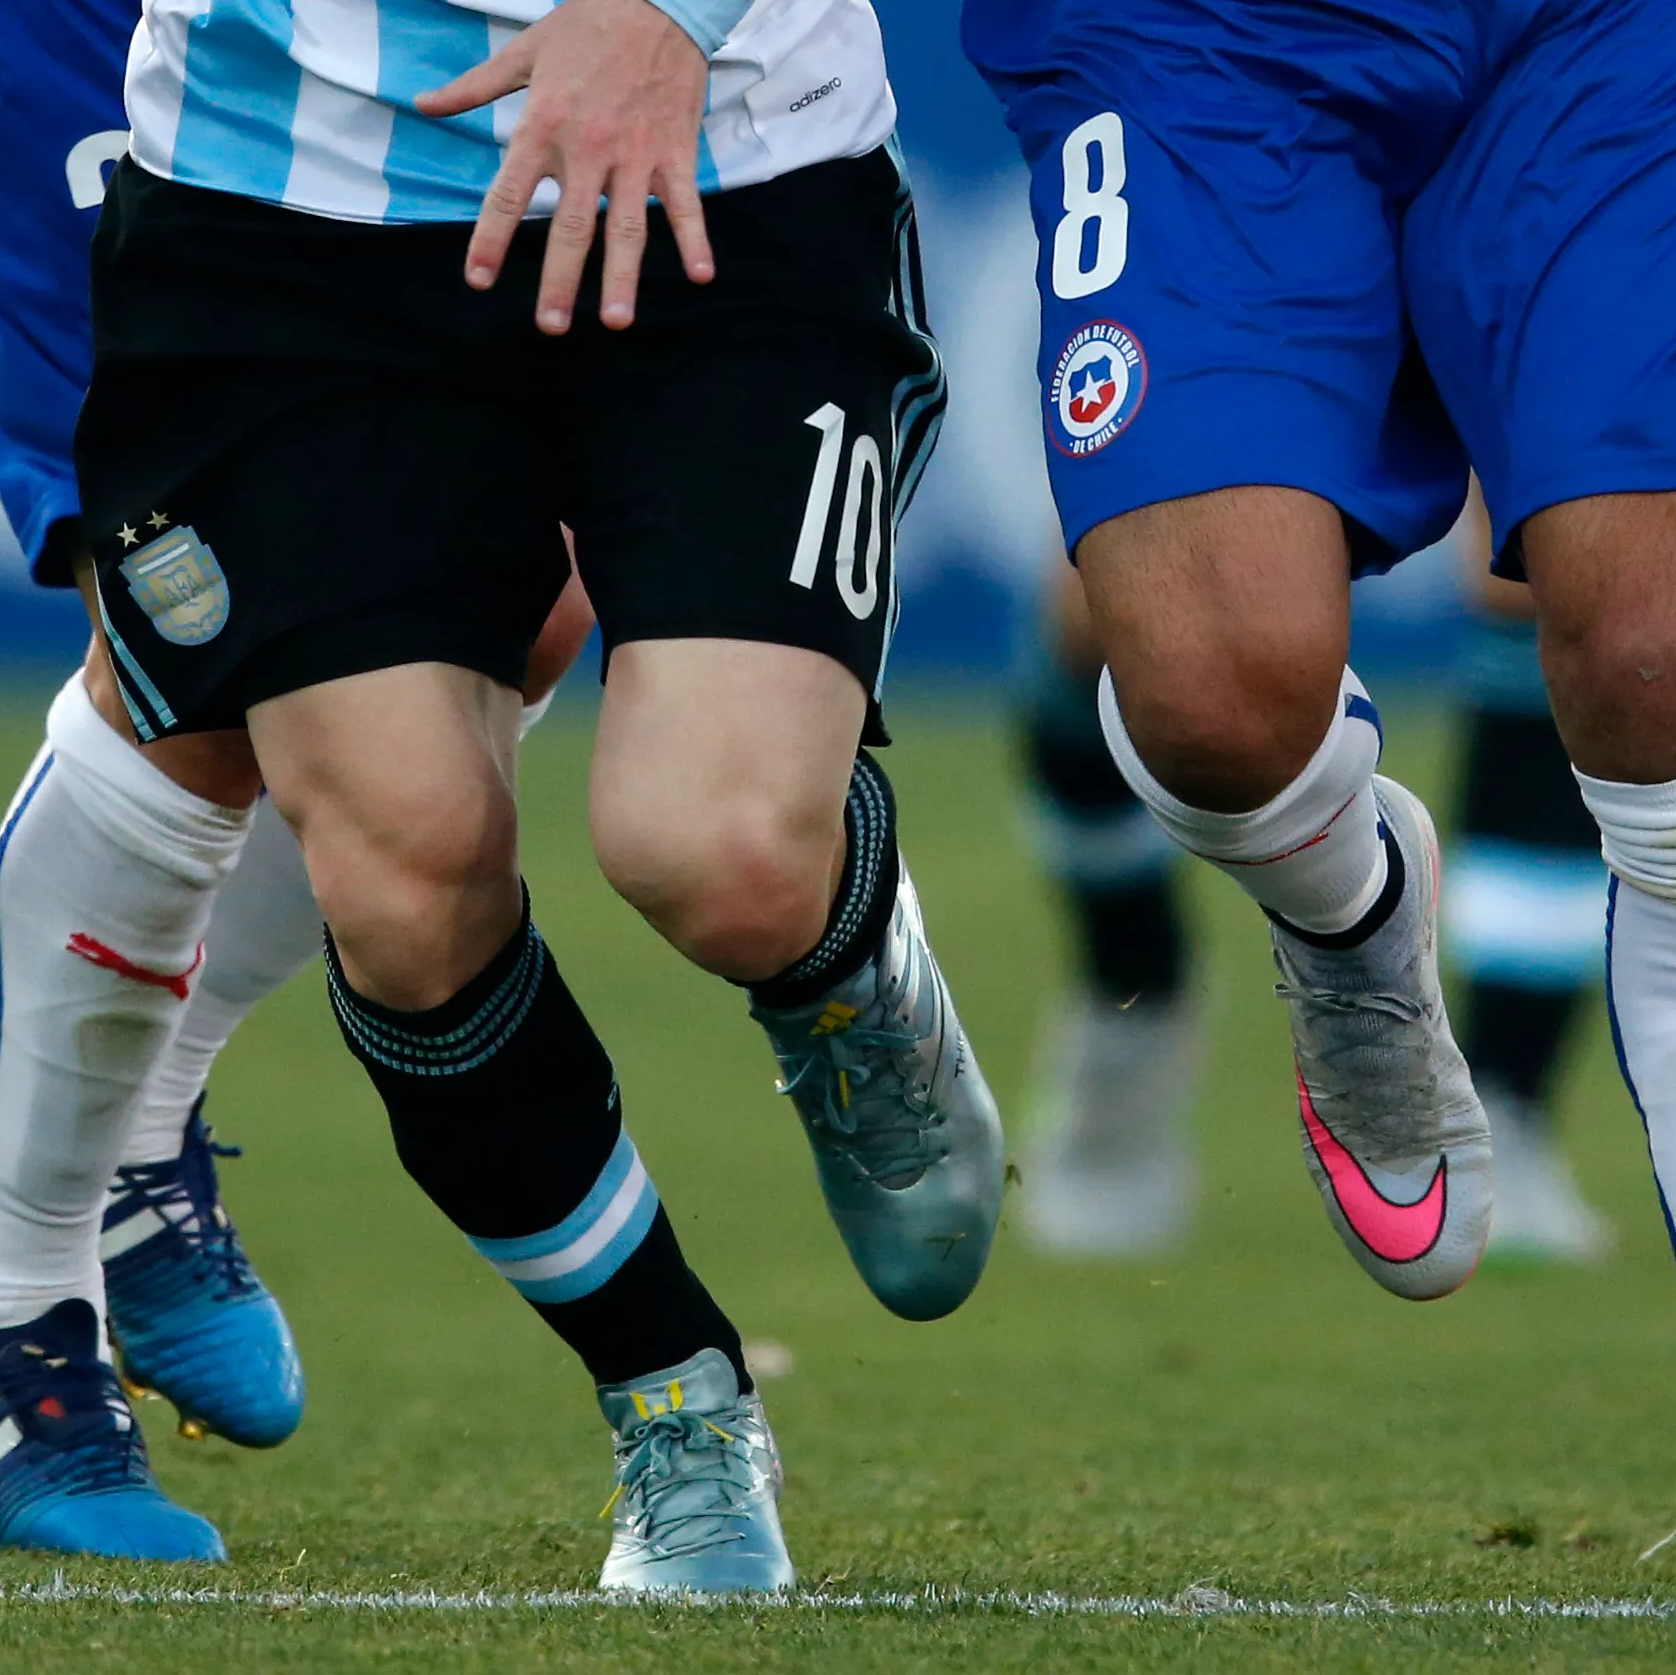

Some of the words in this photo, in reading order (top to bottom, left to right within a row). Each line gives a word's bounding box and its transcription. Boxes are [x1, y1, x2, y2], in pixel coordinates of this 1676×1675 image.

[789, 77, 842, 112] adizero
[1051, 111, 1127, 300] 8
[1051, 327, 1091, 403] FEDERACION
[1092, 324, 1106, 338] DE
[1106, 327, 1140, 368] FUTBOL
[1073, 439, 1086, 453] DE
[1087, 421, 1119, 451] CHILE
[789, 402, 883, 620] 10
